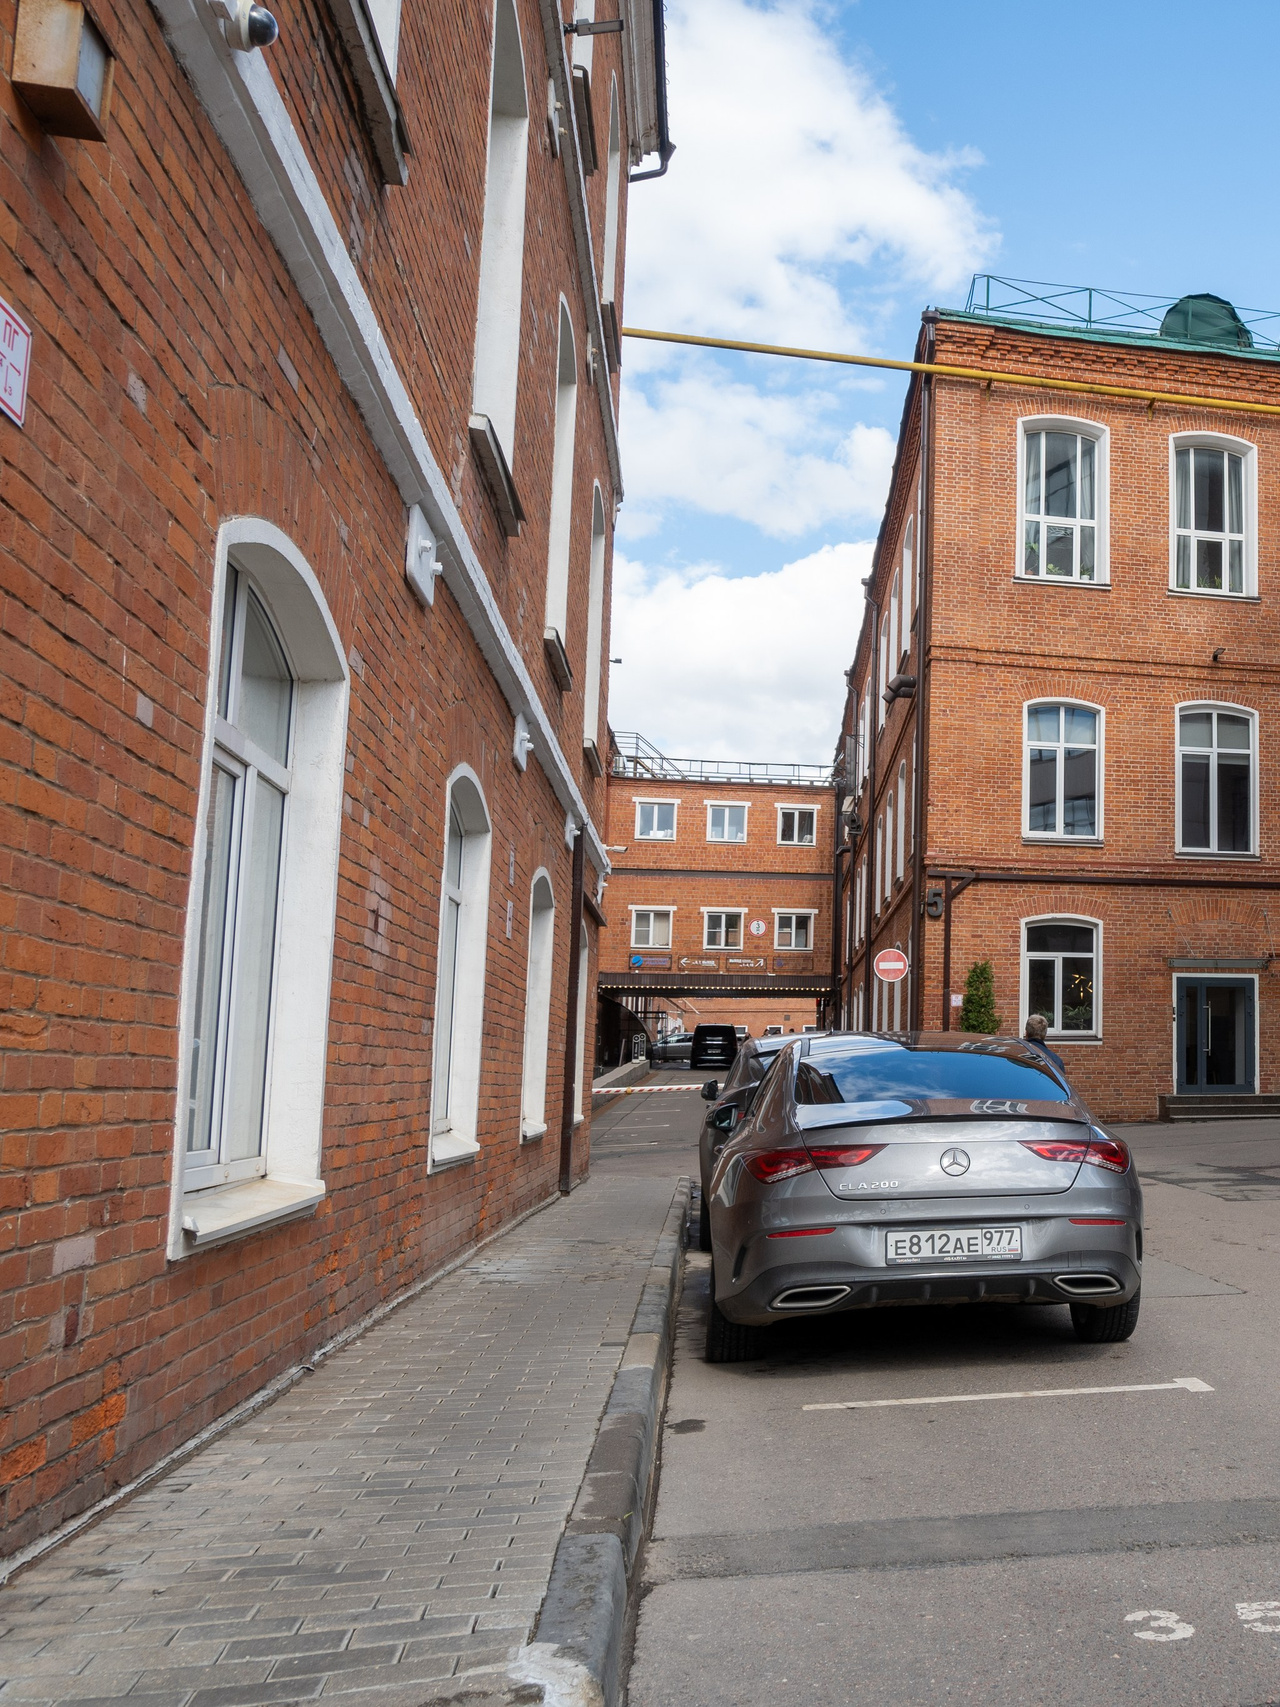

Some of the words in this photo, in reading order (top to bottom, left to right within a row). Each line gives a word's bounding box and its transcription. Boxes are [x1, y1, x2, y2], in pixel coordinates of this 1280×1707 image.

[3, 319, 19, 351] ПГ
[927, 888, 943, 917] 5
[839, 1182, 867, 1190] CLA
[871, 1181, 898, 1189] 200
[895, 1233, 978, 1256] Е812АЕ
[983, 1229, 1015, 1246] 977
